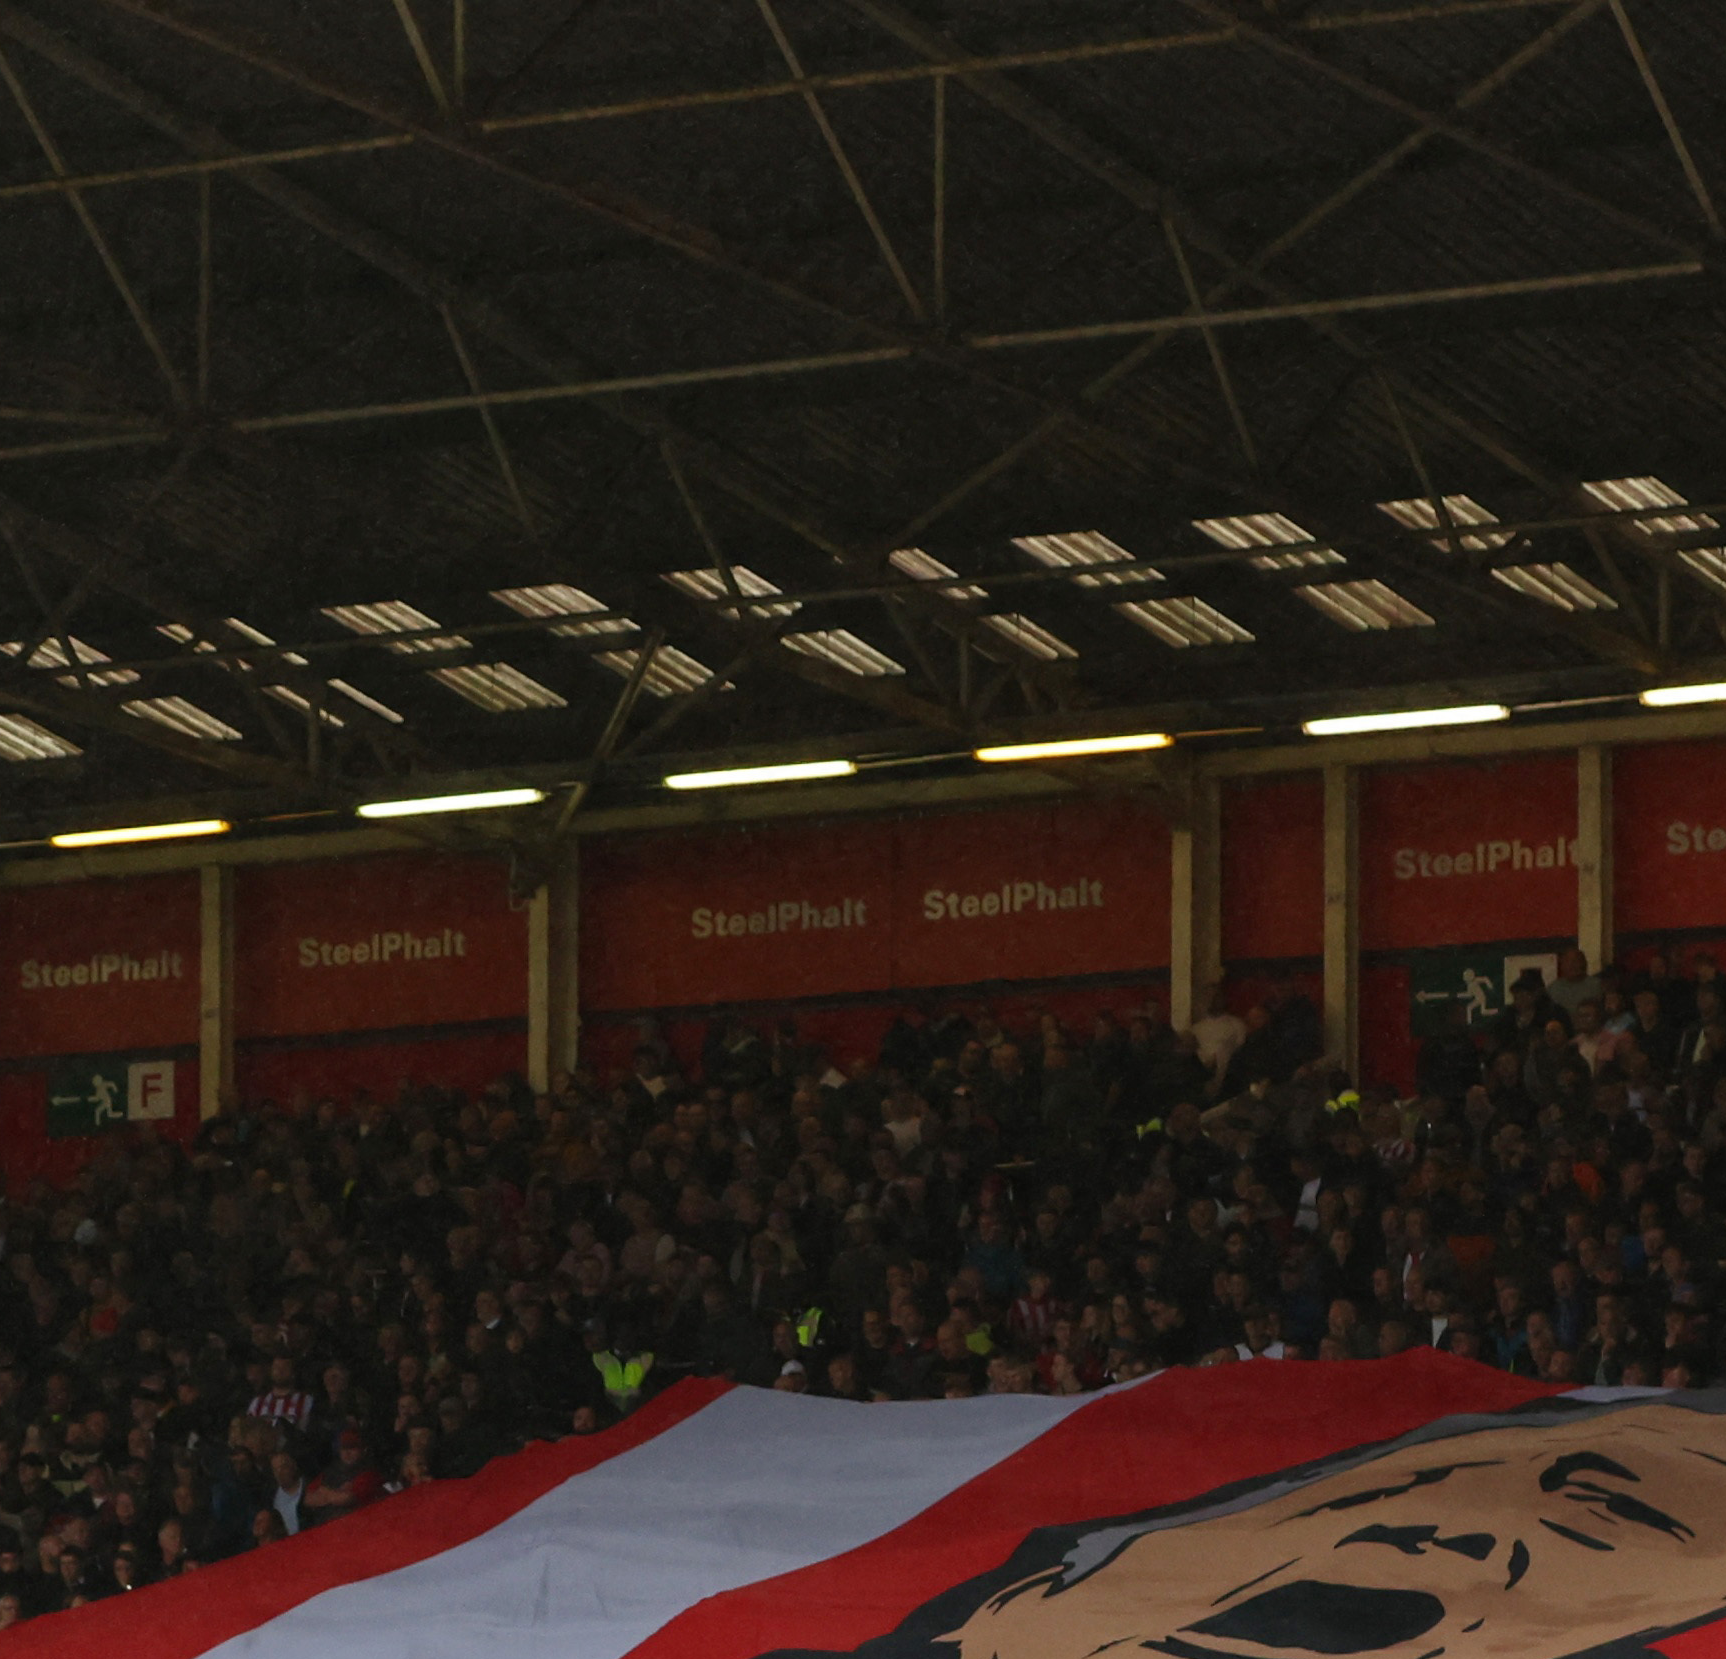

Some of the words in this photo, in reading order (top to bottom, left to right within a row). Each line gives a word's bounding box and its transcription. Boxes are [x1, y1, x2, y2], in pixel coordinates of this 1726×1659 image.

[923, 877, 1104, 919] SteelPhalt
[691, 898, 867, 938] SteelPhalt
[299, 928, 466, 967] SteelPhalt
[22, 951, 183, 989] SteelPhalt
[140, 1073, 162, 1108] F
